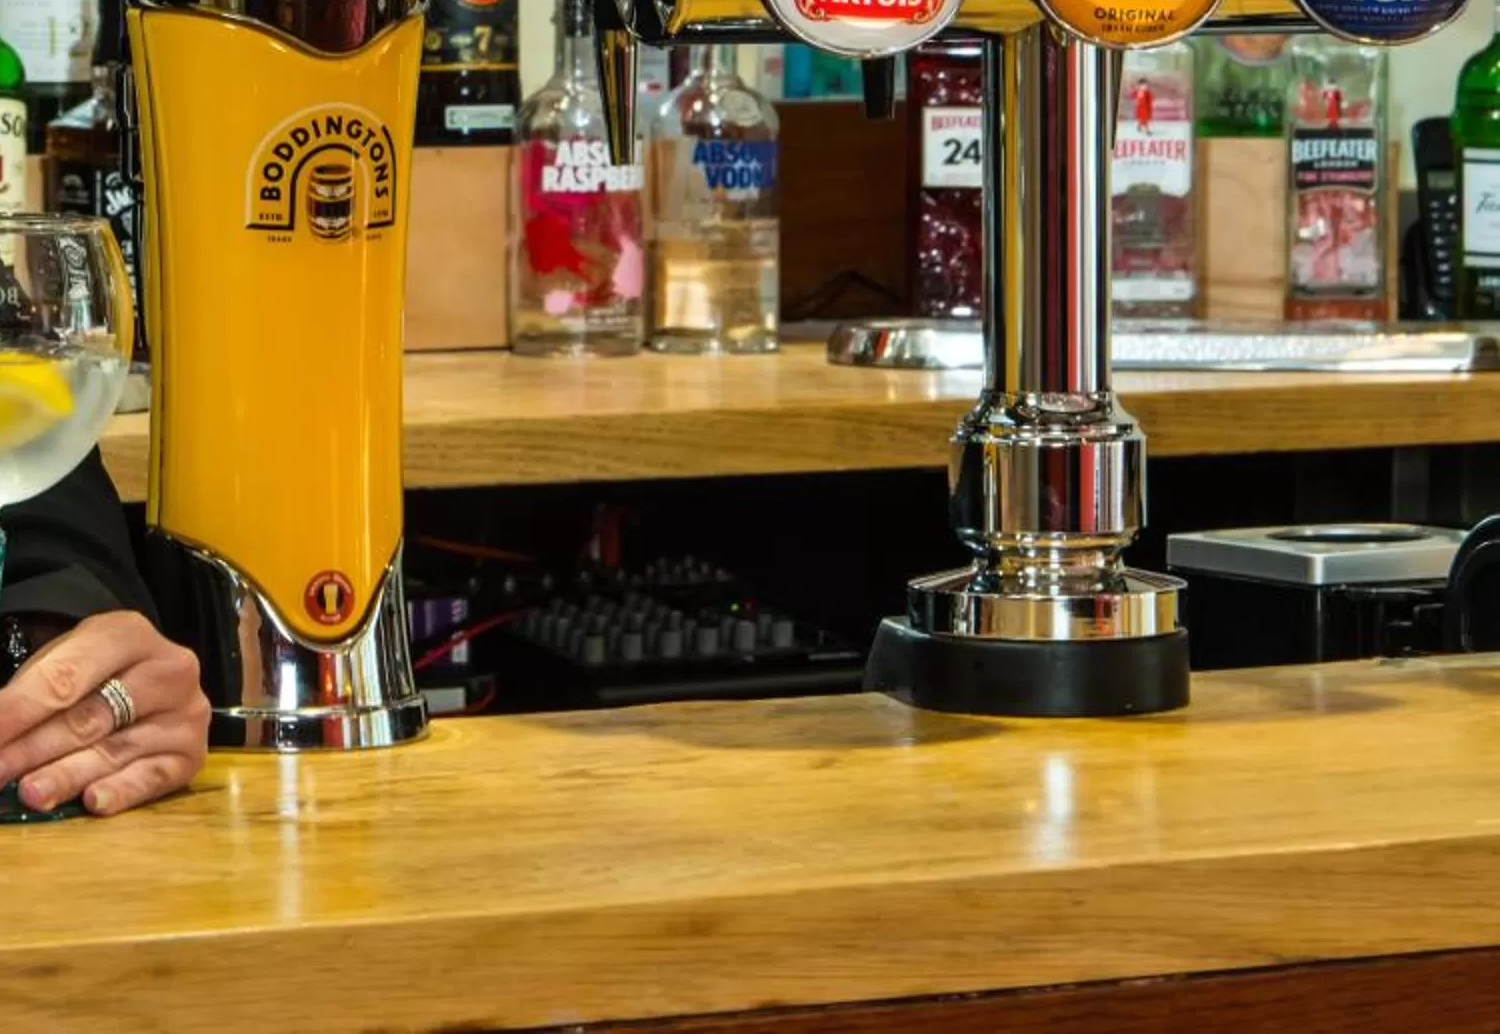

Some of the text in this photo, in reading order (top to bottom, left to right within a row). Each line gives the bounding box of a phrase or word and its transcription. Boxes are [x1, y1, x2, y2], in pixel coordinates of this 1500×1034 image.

[1094, 5, 1177, 23] ORIGINAL
[474, 25, 493, 53] 7
[260, 115, 389, 201] BODDINGTONS
[941, 137, 983, 166] 24
[1112, 137, 1187, 162] EEFEATER
[1292, 138, 1379, 164] BEEFEATER
